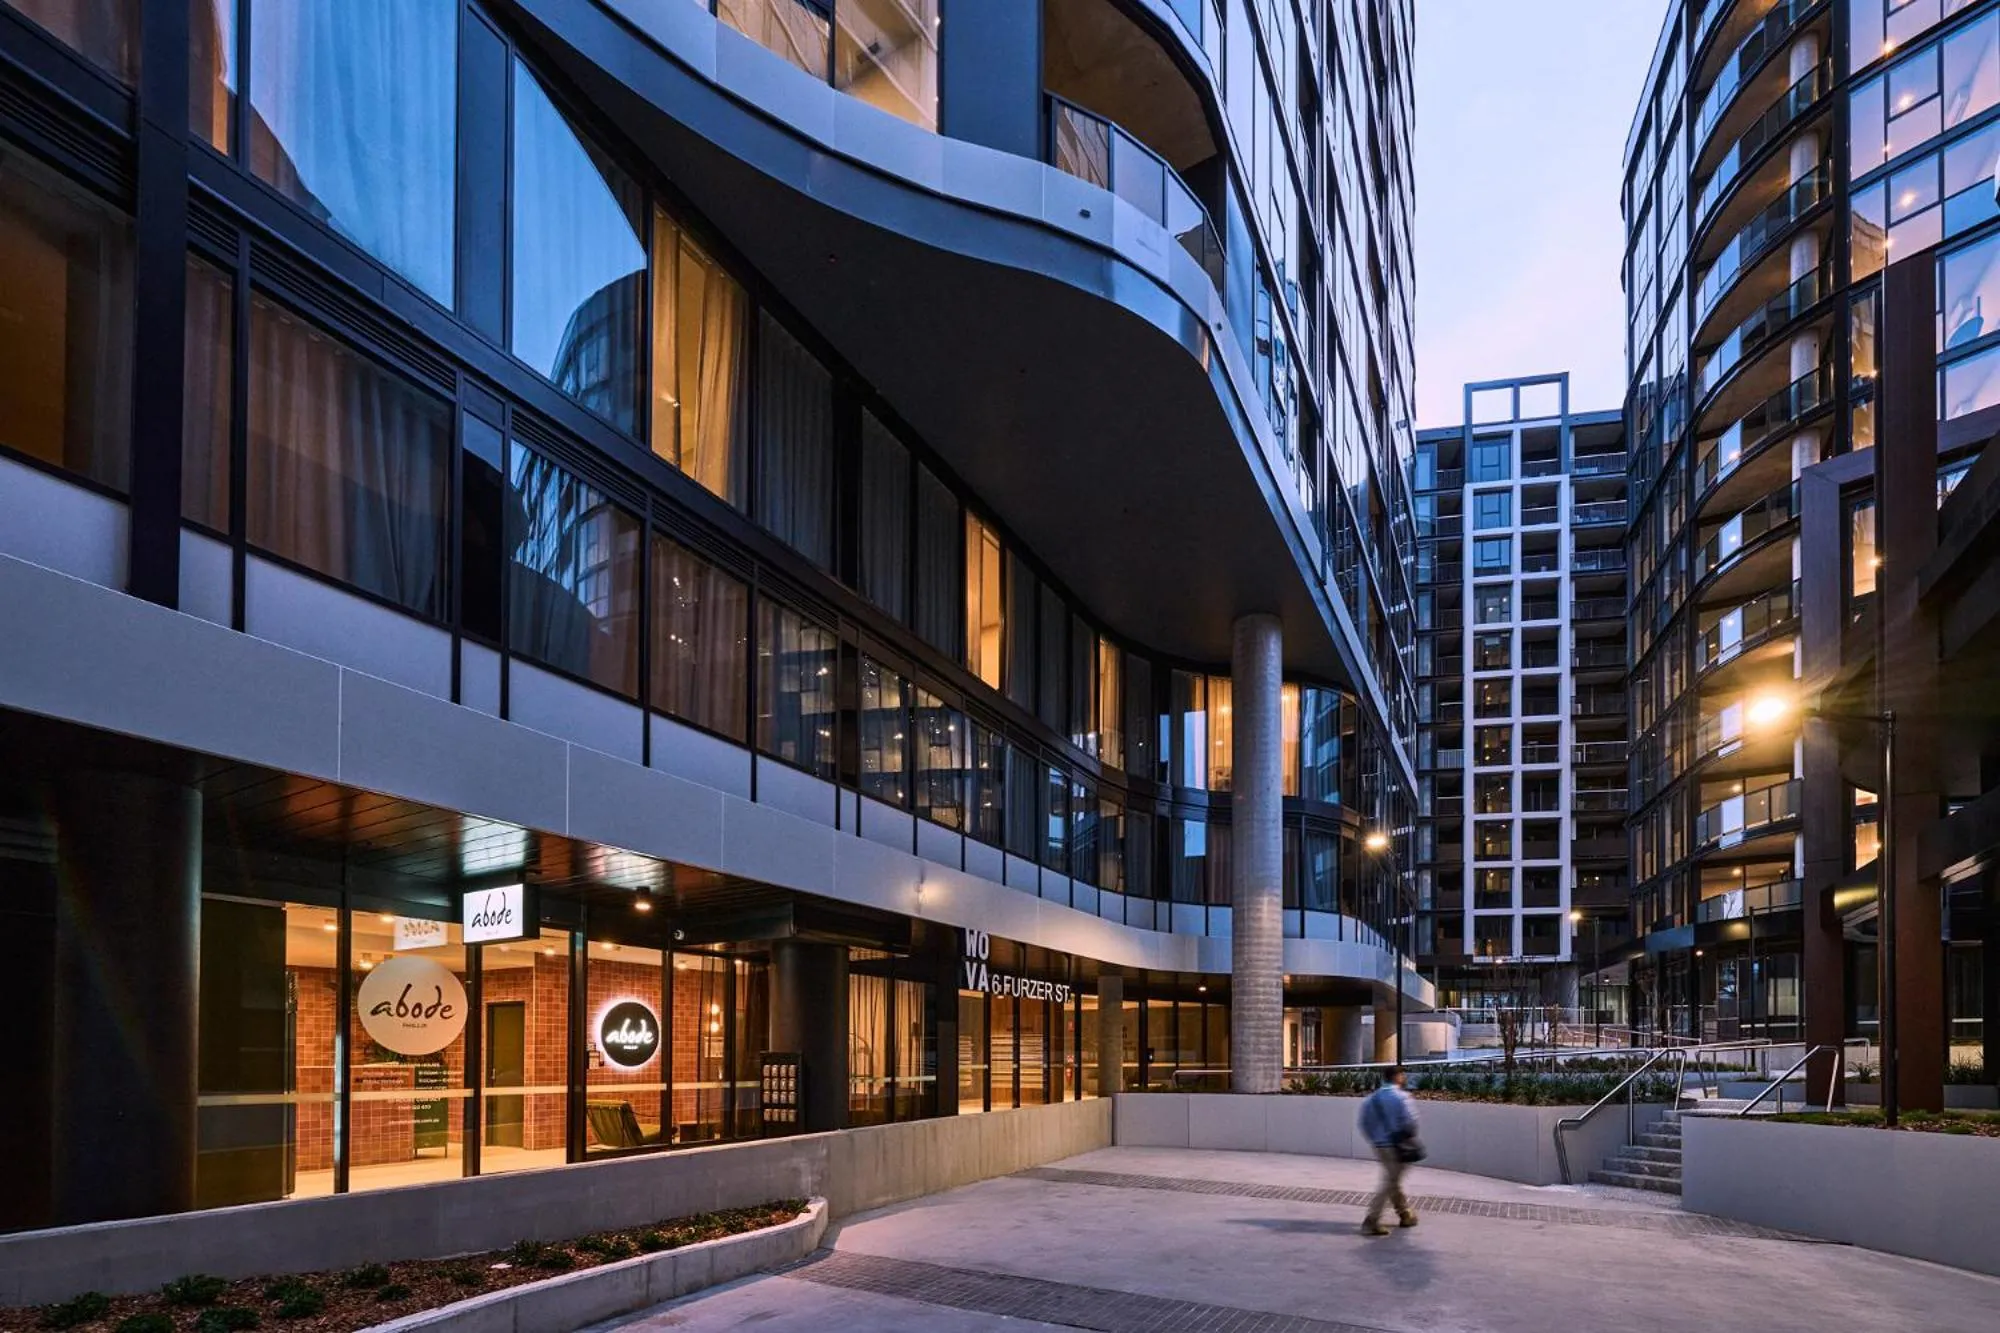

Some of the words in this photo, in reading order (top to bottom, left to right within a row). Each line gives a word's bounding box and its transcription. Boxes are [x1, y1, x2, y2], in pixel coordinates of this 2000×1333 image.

[471, 891, 513, 928] abode
[965, 928, 989, 960] WO
[965, 961, 990, 992] VA
[991, 974, 1002, 995] 6
[1003, 975, 1053, 1002] FURZER
[370, 983, 457, 1019] abode
[605, 1018, 654, 1044] abode
